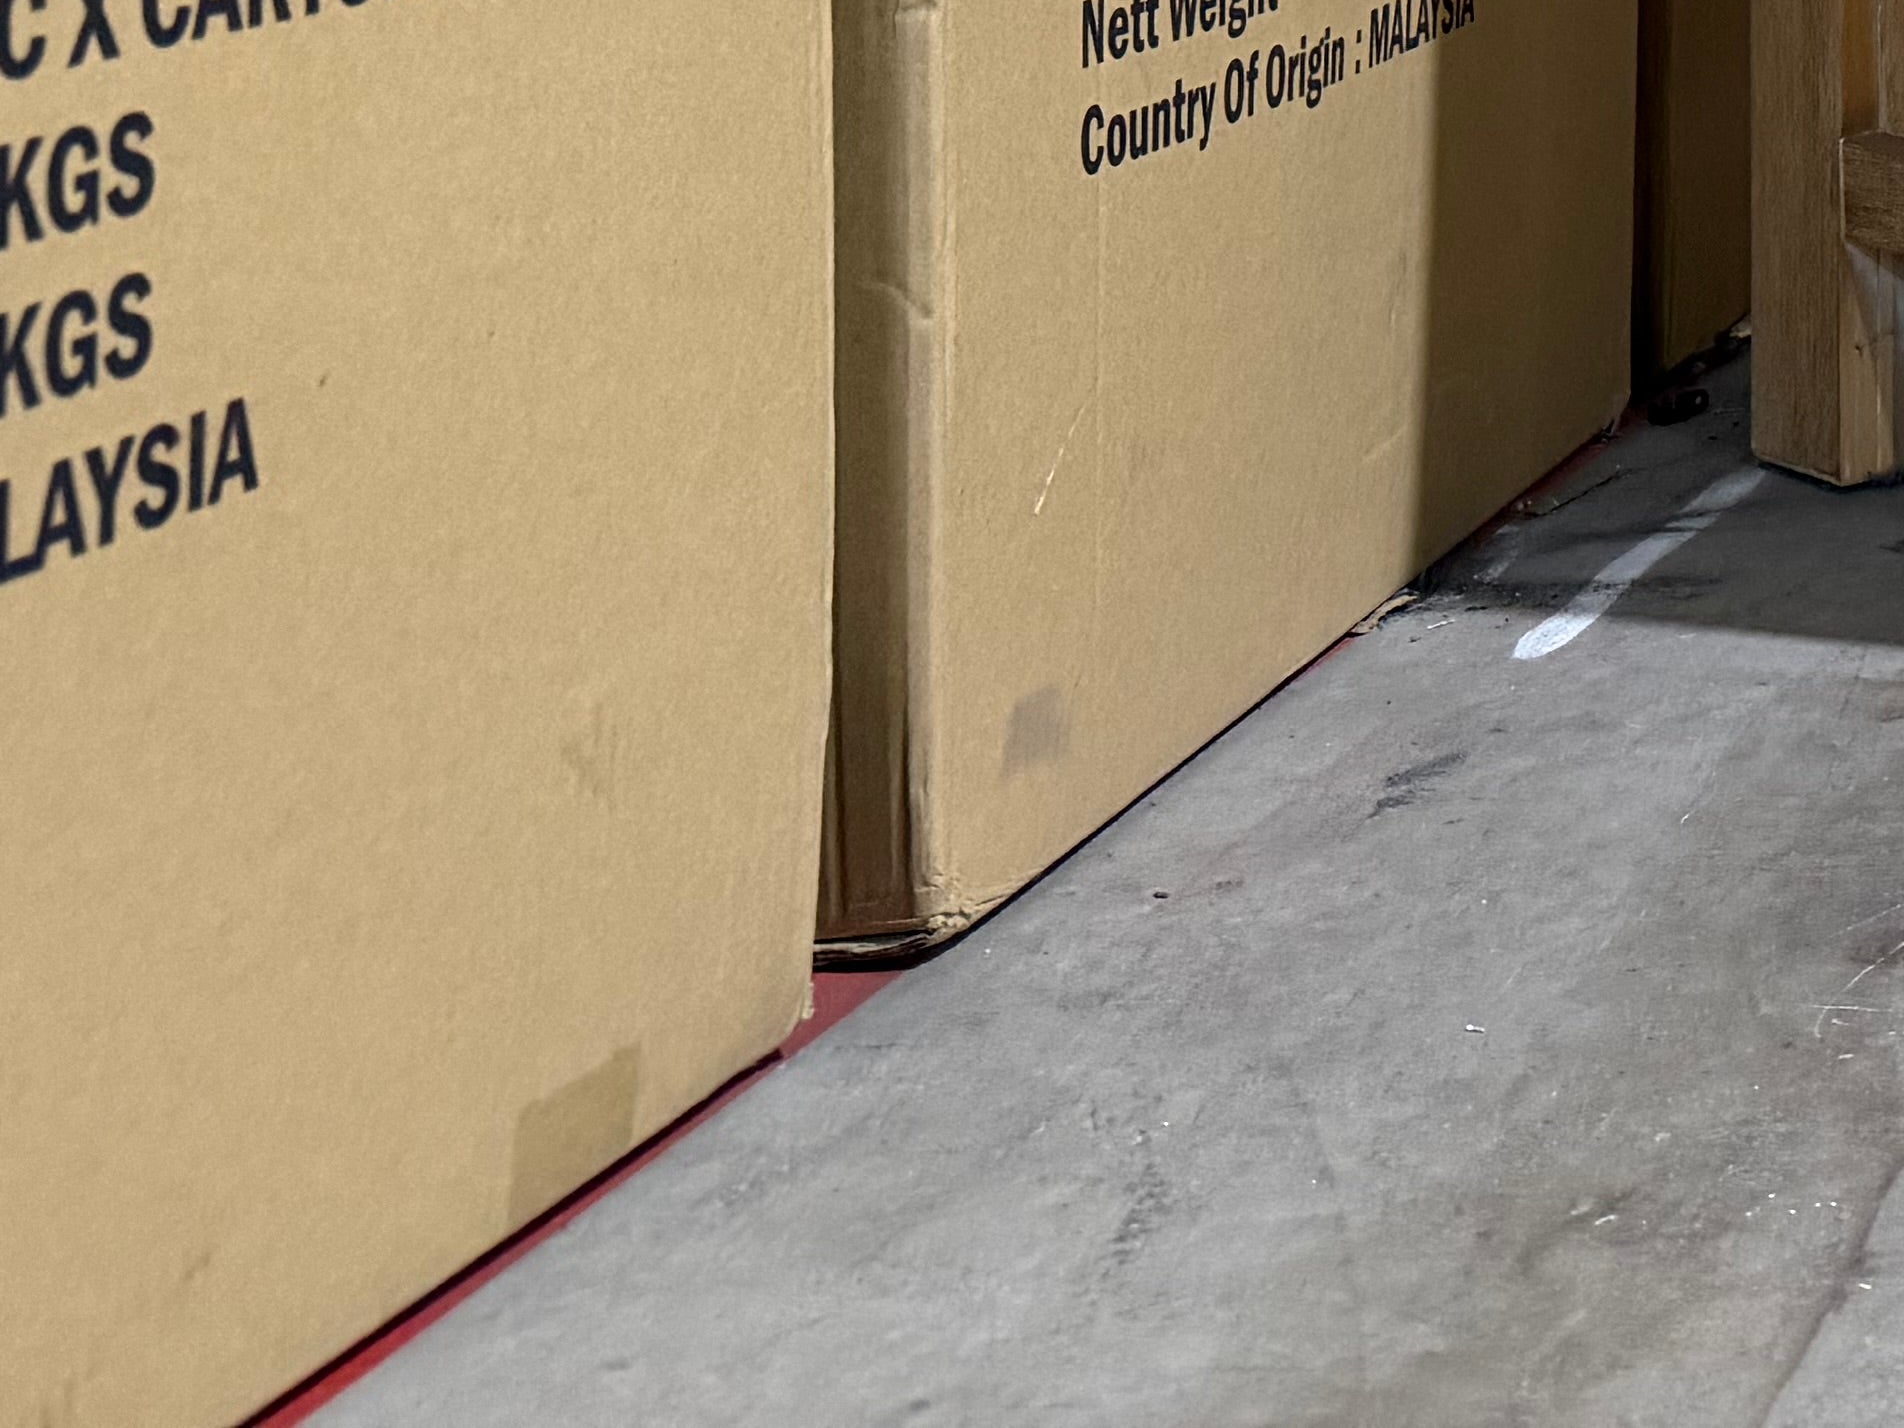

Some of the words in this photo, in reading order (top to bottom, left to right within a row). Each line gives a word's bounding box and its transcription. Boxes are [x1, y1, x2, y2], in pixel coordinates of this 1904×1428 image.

[1081, 79, 1216, 175] Country
[1224, 50, 1259, 124] Of
[1266, 27, 1345, 109] Origin
